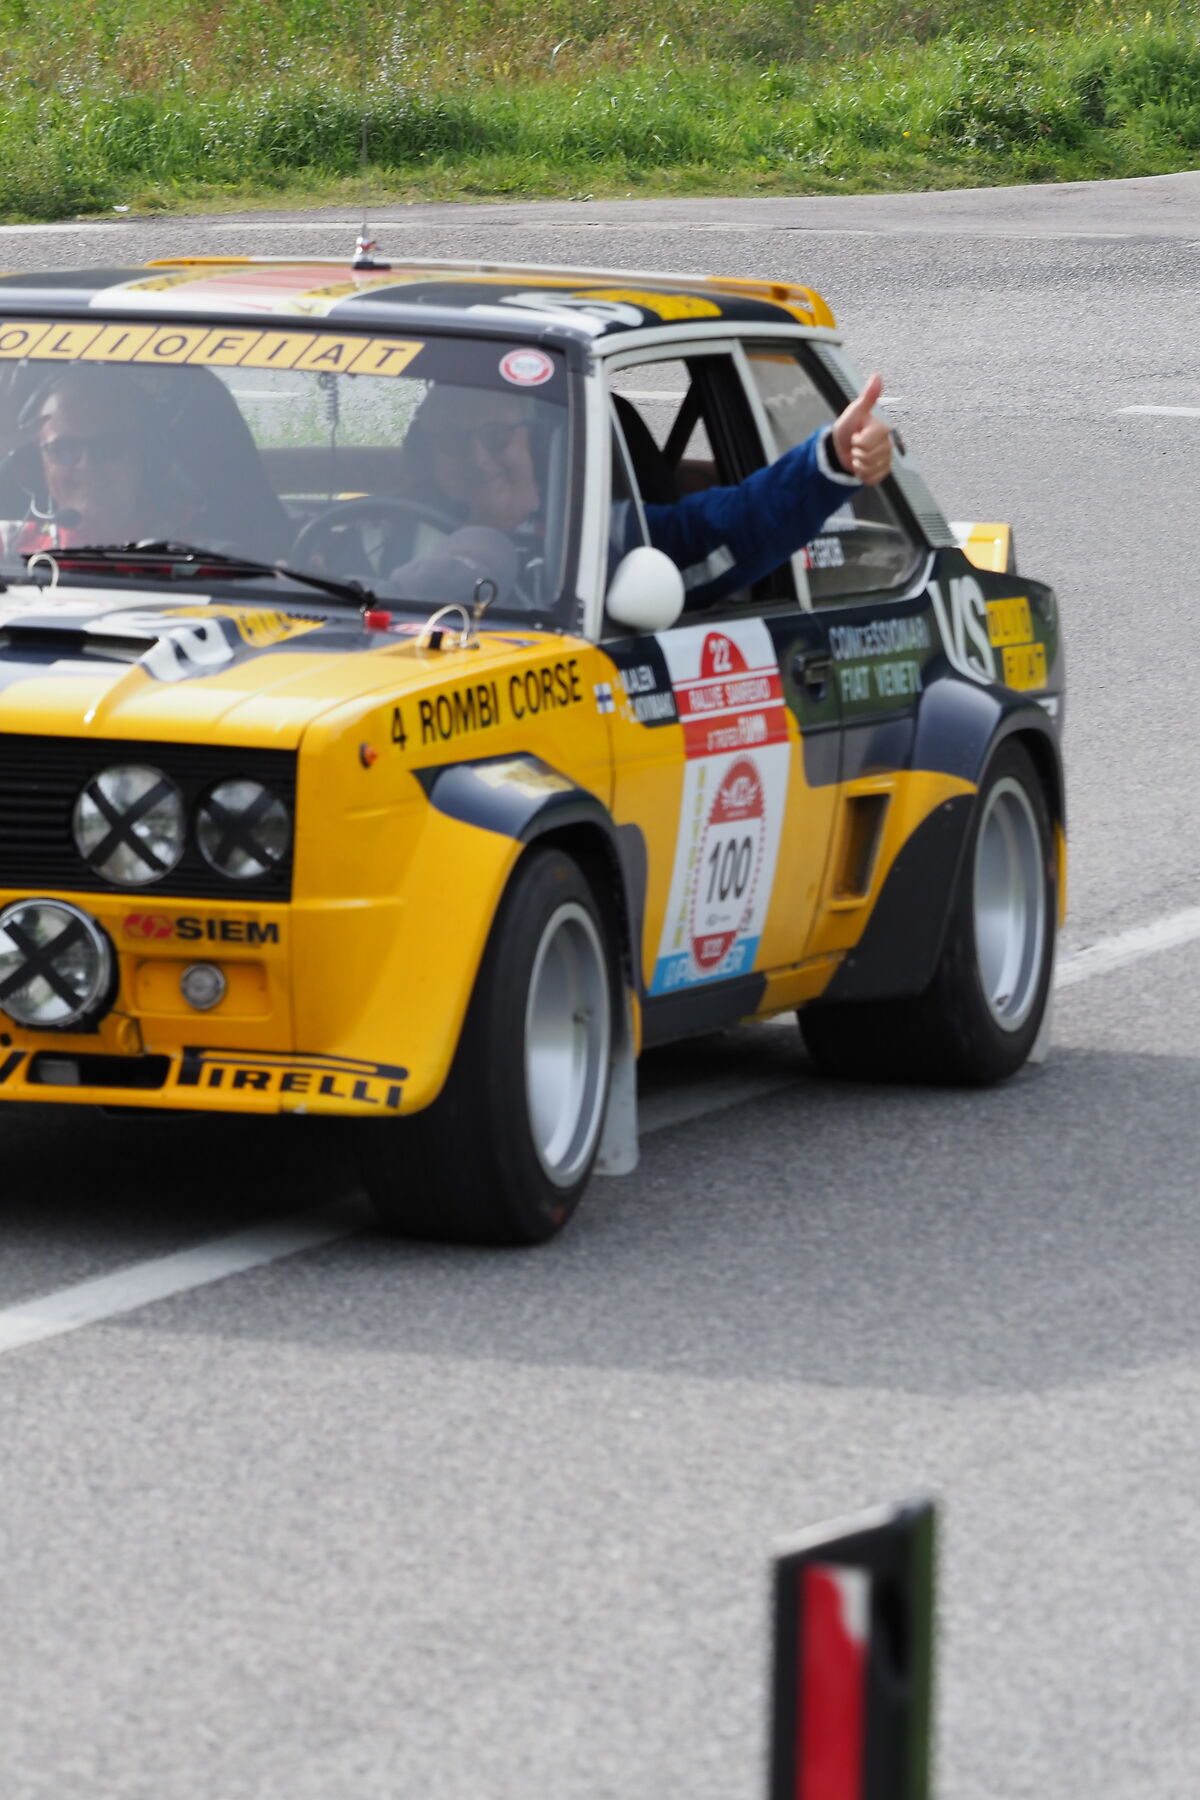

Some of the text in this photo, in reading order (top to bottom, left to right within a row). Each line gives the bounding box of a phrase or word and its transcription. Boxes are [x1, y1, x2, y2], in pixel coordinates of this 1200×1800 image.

[709, 637, 733, 673] 22
[391, 659, 582, 751] 4 ROMBI CORSE
[706, 836, 753, 904] 100
[175, 917, 280, 944] SIEM
[176, 1046, 409, 1109] PIRELLI
